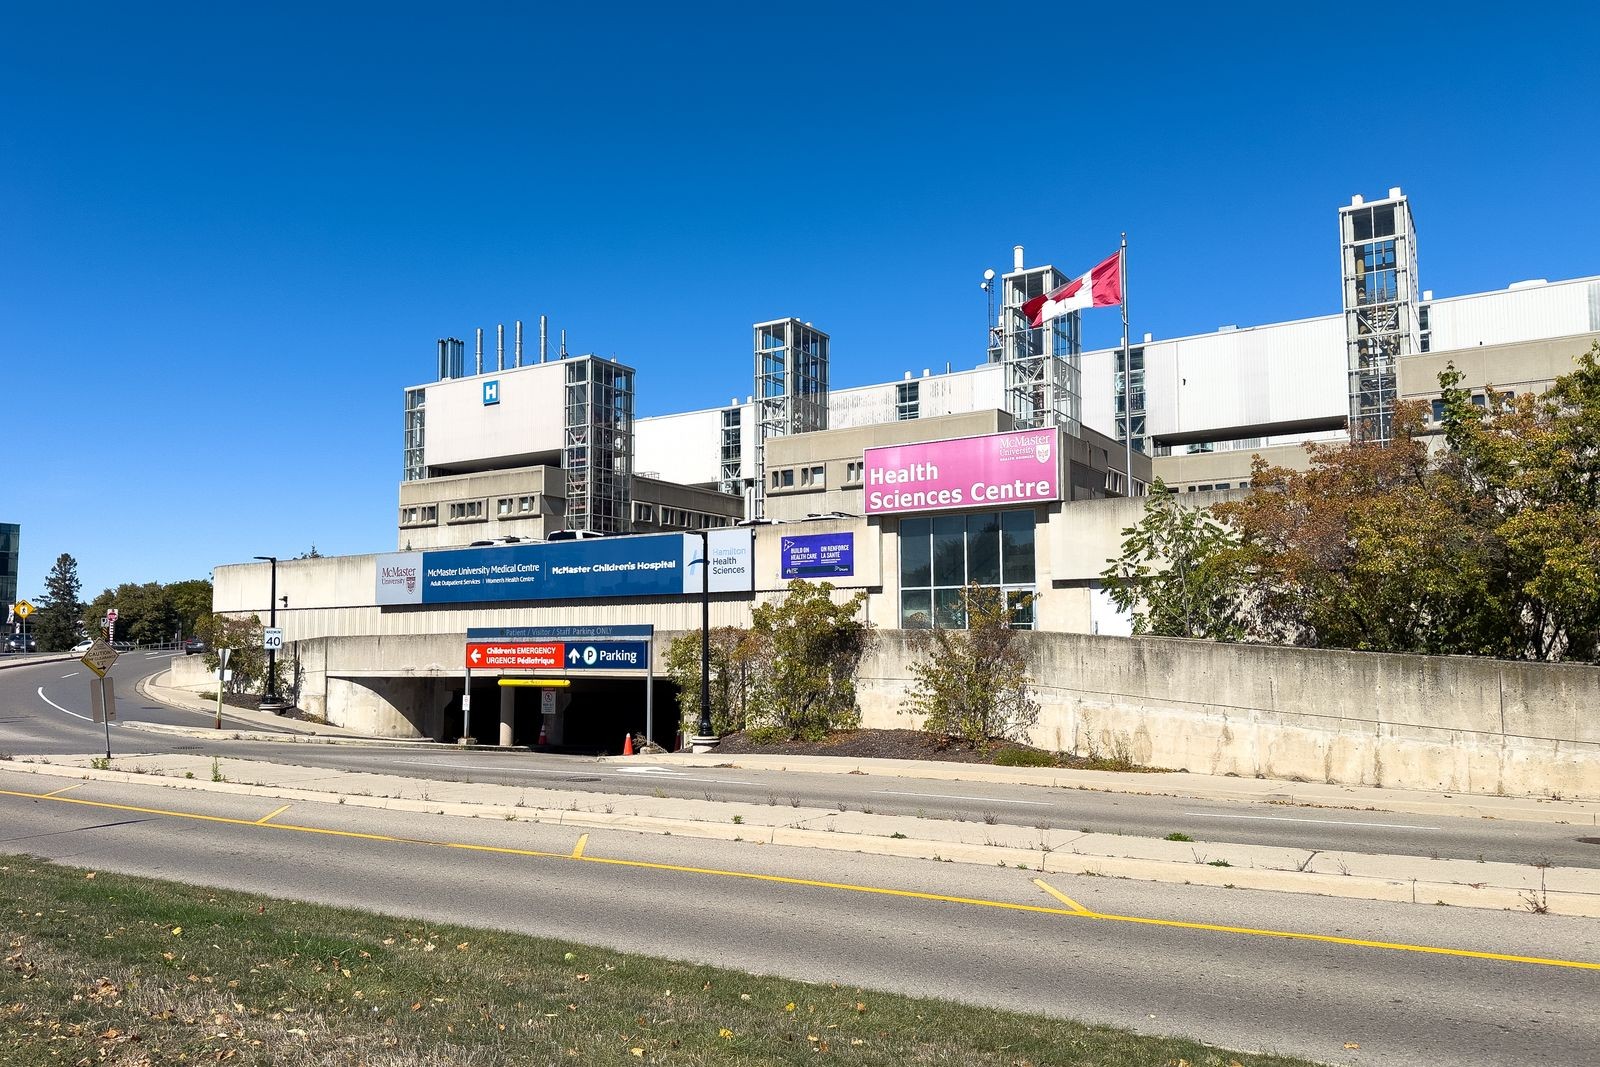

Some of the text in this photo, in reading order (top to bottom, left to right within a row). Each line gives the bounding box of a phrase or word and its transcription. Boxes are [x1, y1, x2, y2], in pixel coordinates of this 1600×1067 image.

[486, 384, 496, 400] H
[1000, 435, 1050, 448] McMaster
[1000, 446, 1035, 456] University
[870, 462, 938, 485] Health
[870, 479, 1050, 509] Sciences Centre
[712, 547, 746, 555] Hamilton
[712, 557, 737, 565] Health
[382, 567, 416, 578] McMaster
[428, 563, 540, 577] McMaster University Medical Centre
[552, 560, 676, 575] McMaster Children's Hospital
[712, 565, 745, 575] Sciences
[382, 578, 405, 586] University
[442, 579, 462, 587] Outpatient
[532, 628, 551, 636] Visitor
[573, 627, 594, 636] Parking
[266, 637, 280, 646] 40
[517, 656, 555, 665] Pédiatrique
[587, 649, 637, 663] P Parking
